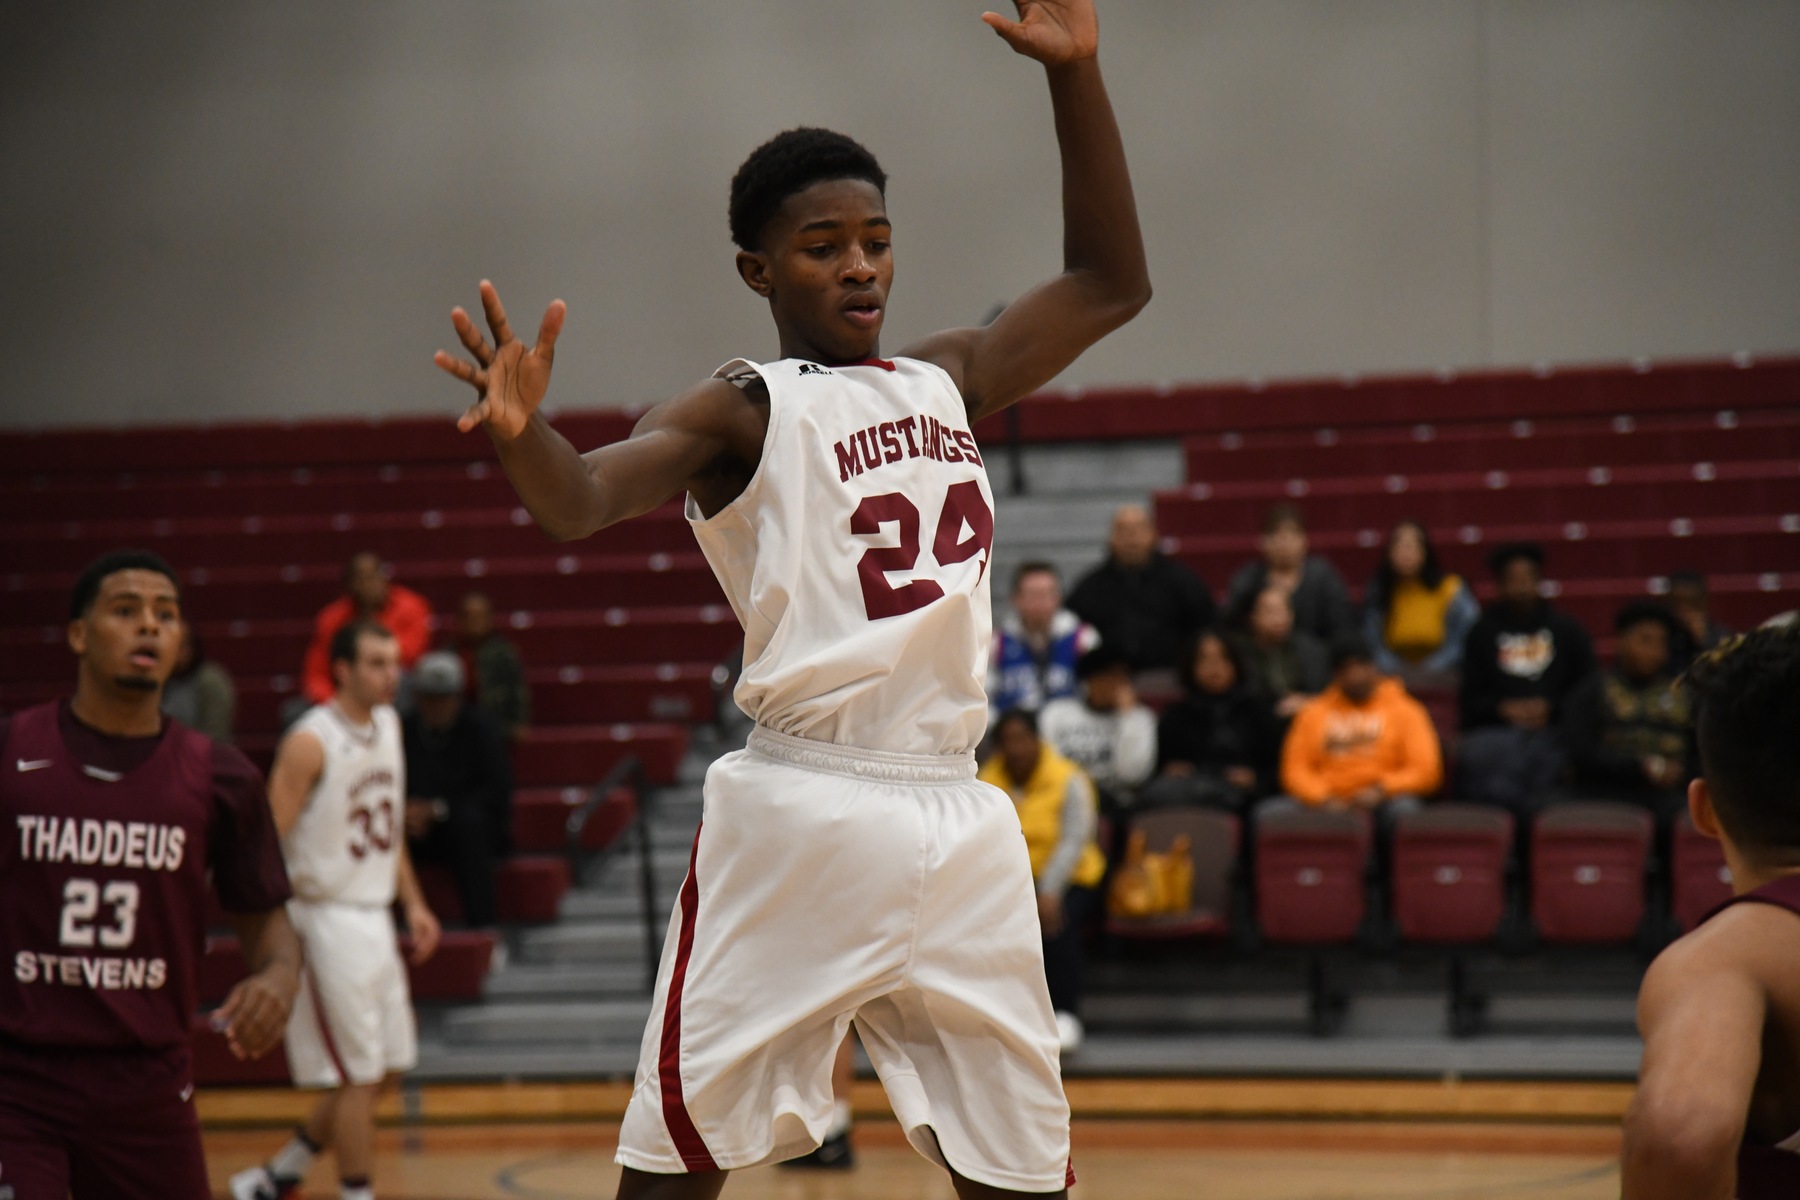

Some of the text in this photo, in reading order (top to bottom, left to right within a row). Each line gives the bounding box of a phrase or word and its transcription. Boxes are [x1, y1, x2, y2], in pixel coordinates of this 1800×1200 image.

[834, 414, 983, 483] MUSTANGS
[850, 480, 994, 621] 24
[16, 814, 187, 872] THADDEUS
[348, 799, 394, 860] 33
[59, 877, 140, 949] 23
[14, 950, 168, 990] STEVENS
